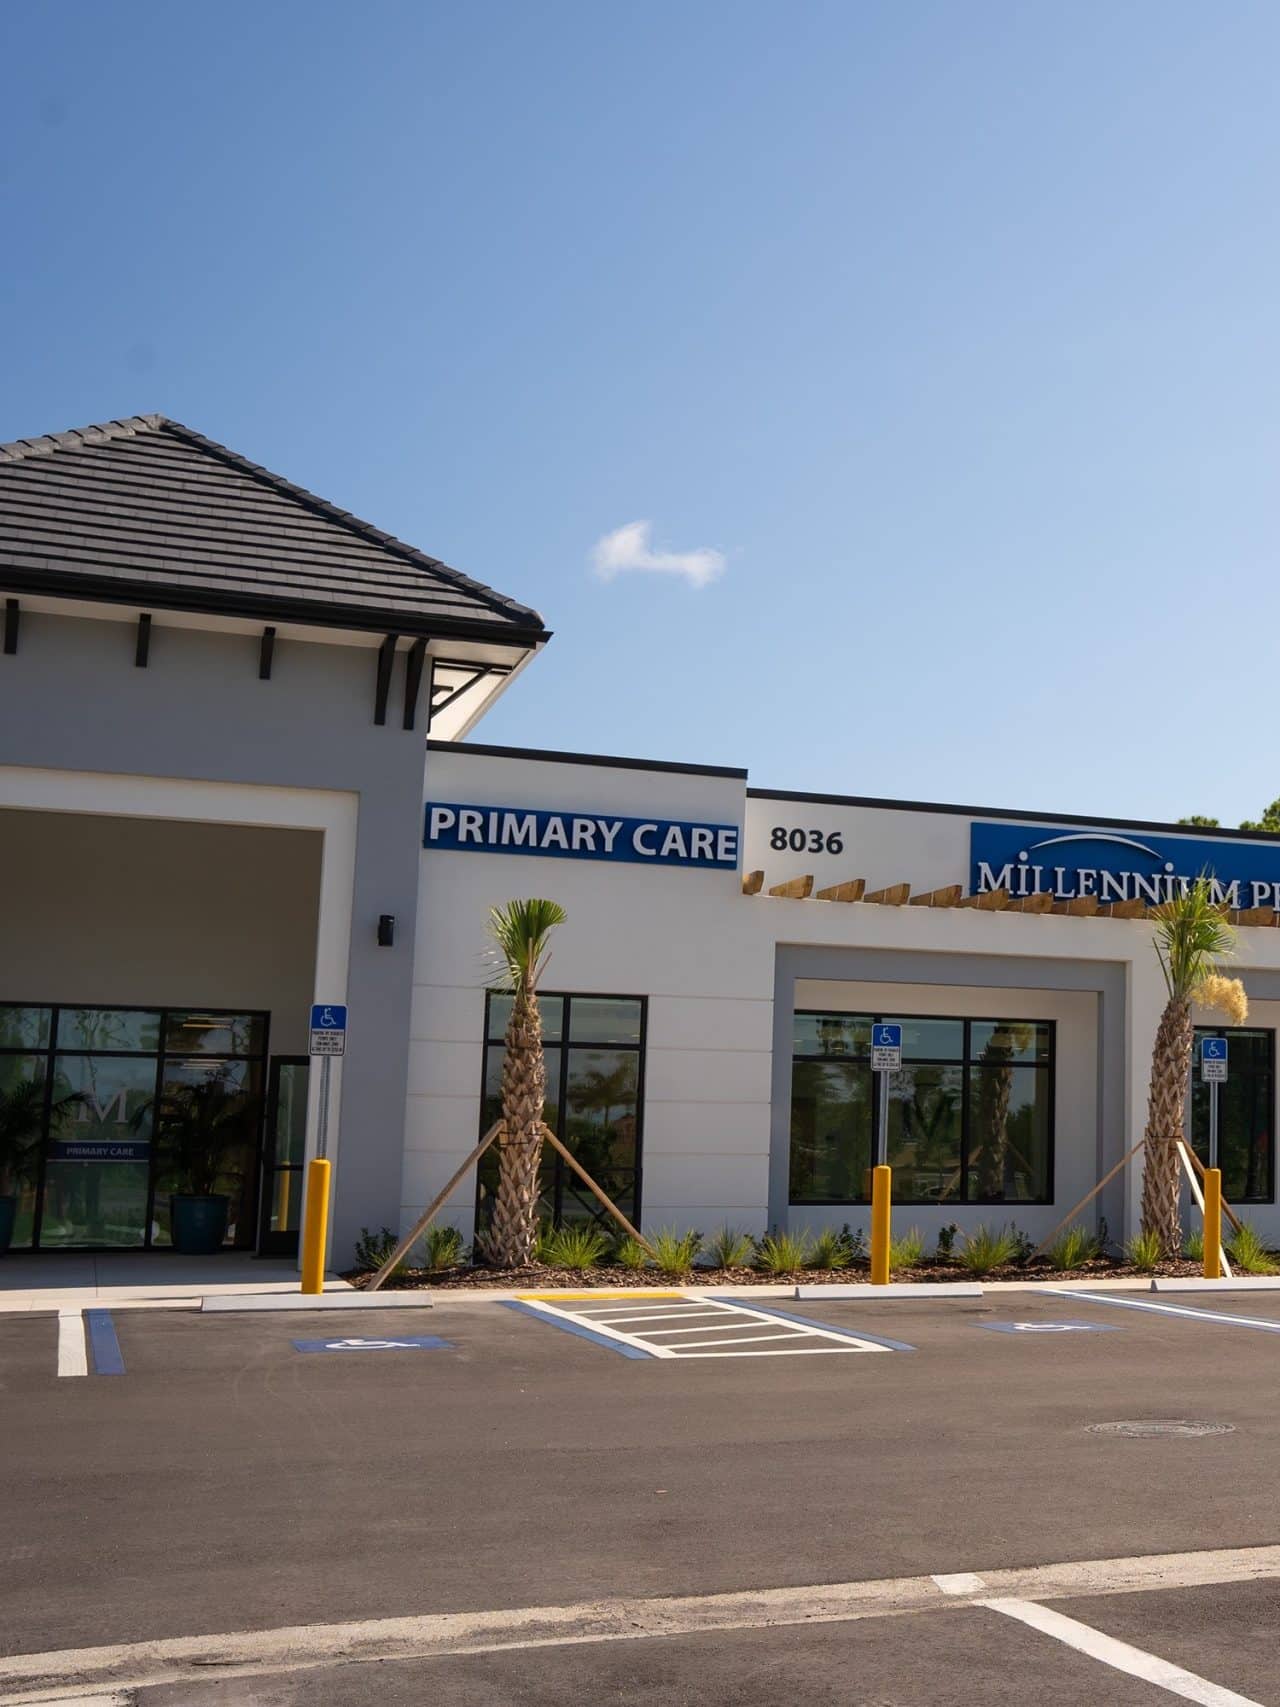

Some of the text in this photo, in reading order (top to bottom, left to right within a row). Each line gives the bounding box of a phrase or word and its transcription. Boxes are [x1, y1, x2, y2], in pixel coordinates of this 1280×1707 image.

[429, 807, 738, 861] PRIMARY CARE
[769, 827, 844, 855] 8036
[66, 1147, 135, 1156] PRIMARY CARE
